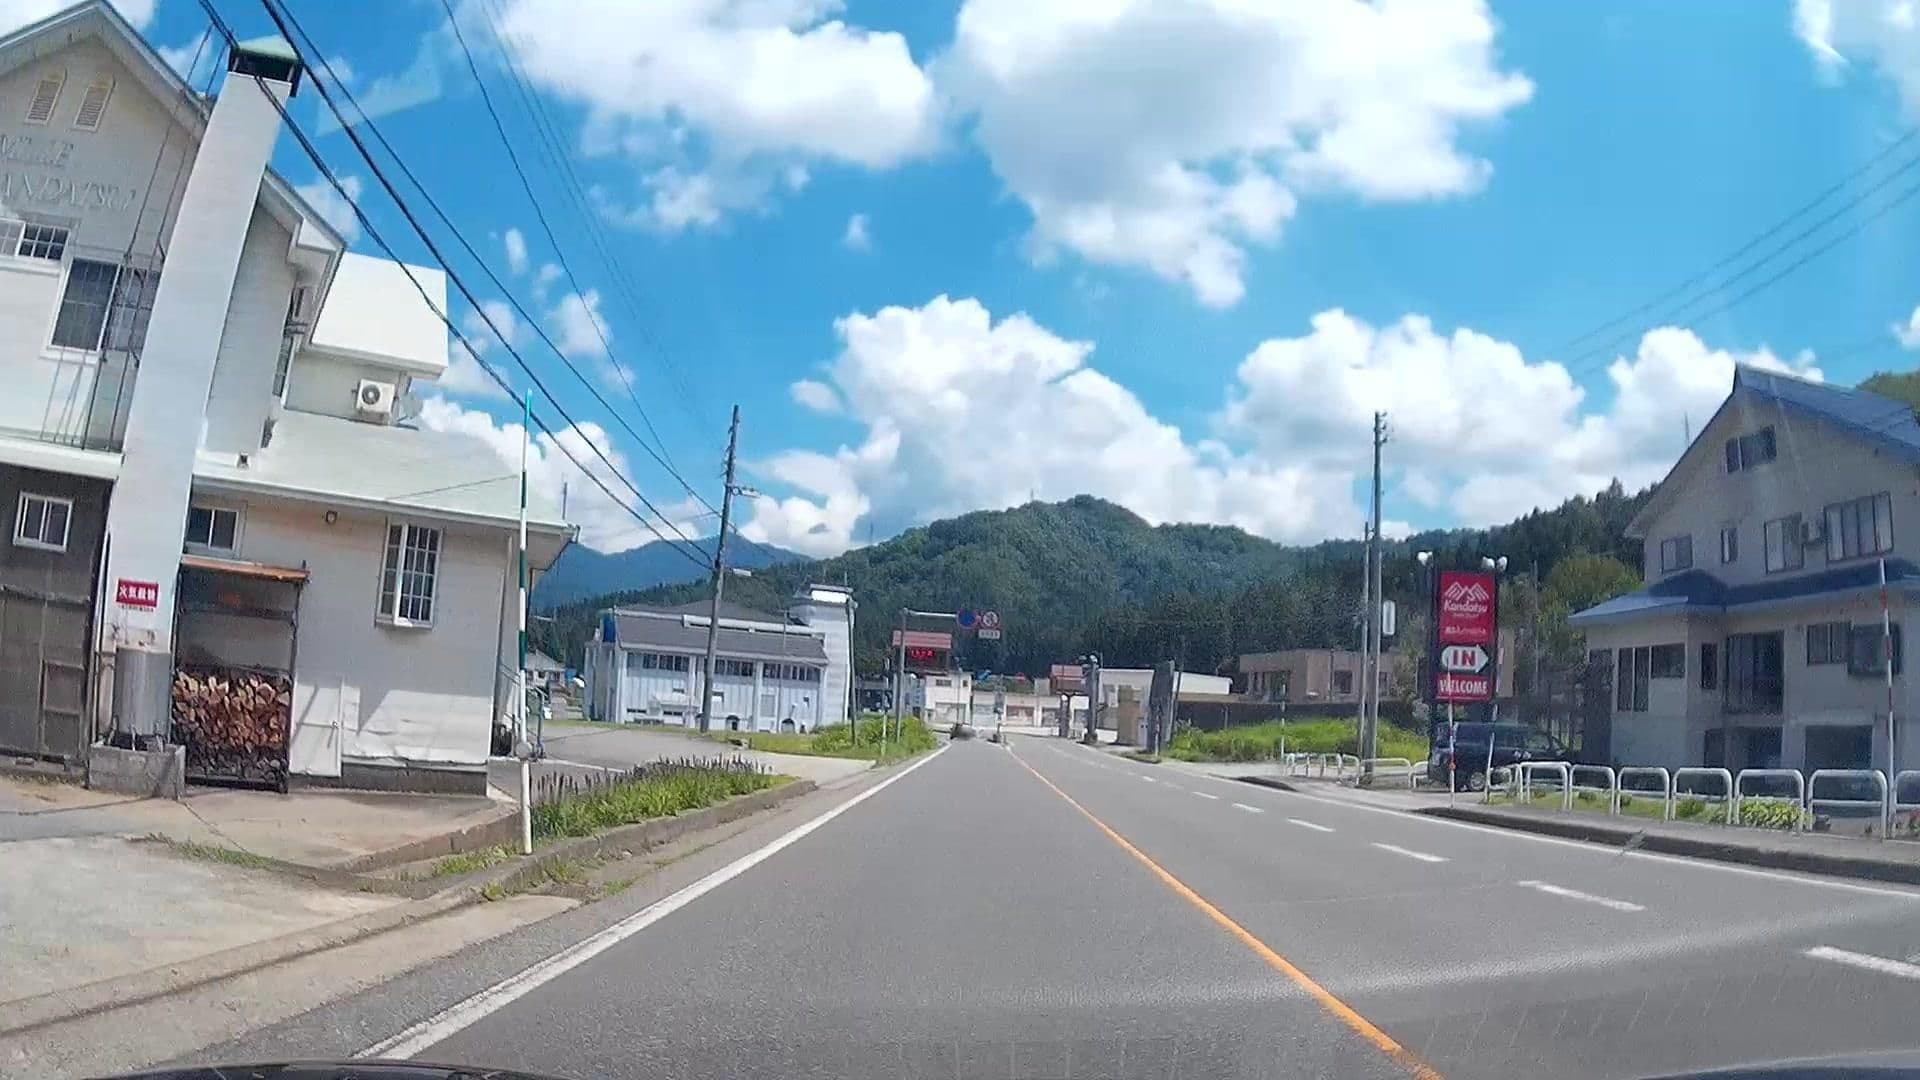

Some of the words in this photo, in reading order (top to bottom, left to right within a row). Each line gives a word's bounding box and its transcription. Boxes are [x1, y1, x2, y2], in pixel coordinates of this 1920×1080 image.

[1444, 599, 1488, 613] Kandatsu
[1452, 649, 1476, 667] IN
[1440, 679, 1488, 695] WELCOME
